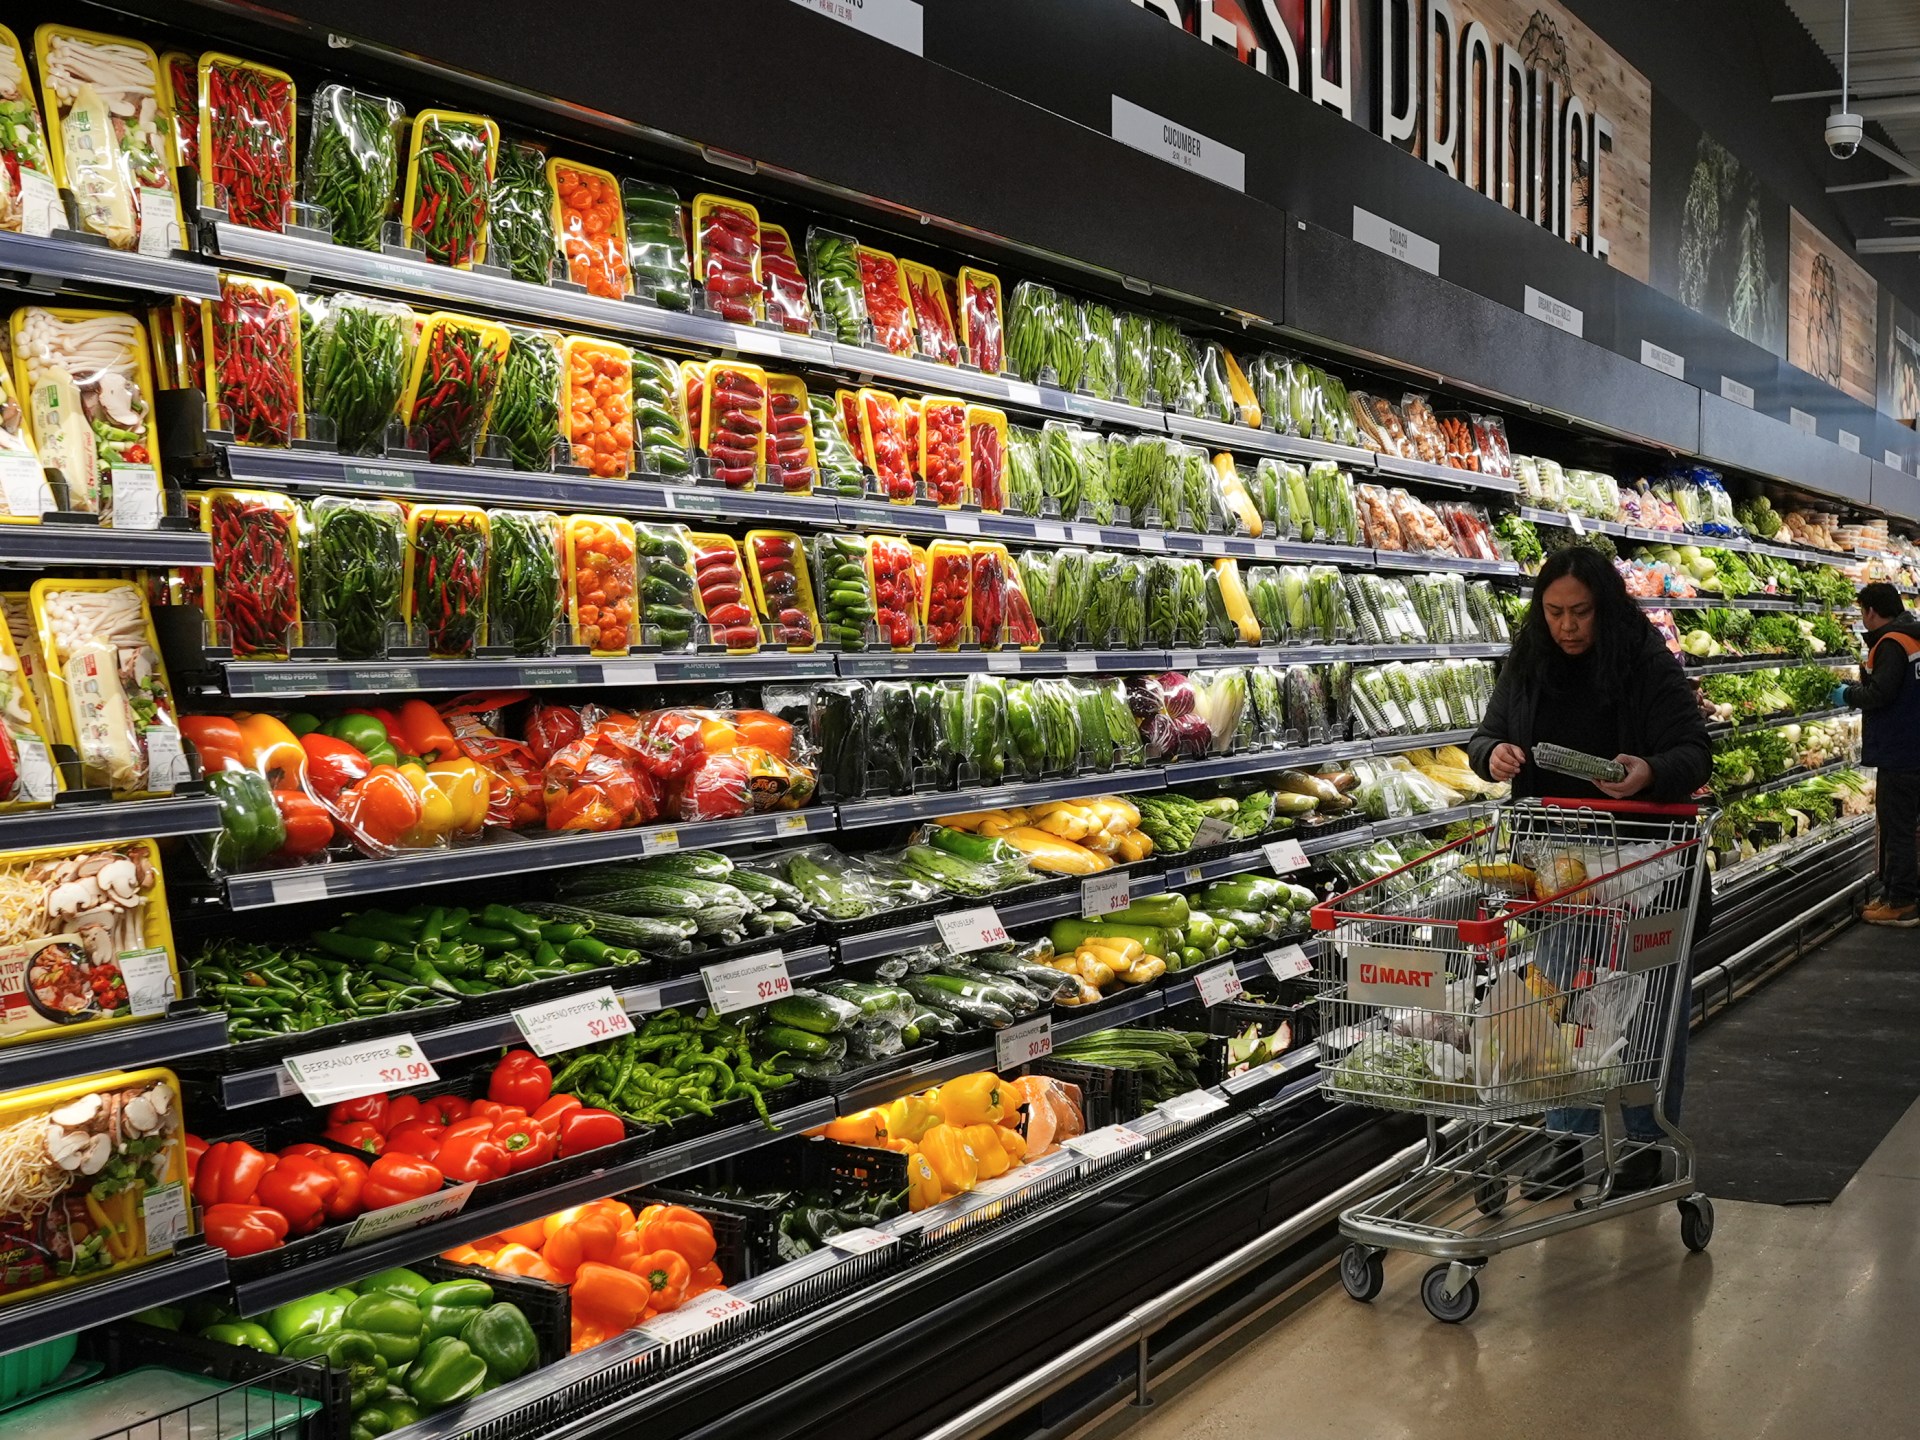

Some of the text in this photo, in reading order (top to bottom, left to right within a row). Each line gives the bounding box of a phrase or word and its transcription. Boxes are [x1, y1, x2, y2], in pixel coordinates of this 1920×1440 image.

[1163, 124, 1201, 158] CUCUMBER
[1390, 227, 1408, 249] SQUASH
[383, 470, 404, 478] PEPPER
[390, 671, 412, 679] PEPPER
[943, 917, 975, 931] CACTUS LEAF
[981, 927, 1006, 944] $1.49
[1643, 930, 1673, 949] MART
[4, 961, 24, 974] TOFU
[712, 963, 769, 983] HOT HOUSE CUCUMBER
[1379, 967, 1434, 988] MART
[0, 975, 20, 992] KIT
[757, 976, 789, 1000] $2.49
[567, 1001, 598, 1016] PEPPER
[587, 1013, 628, 1039] $2.49
[1028, 1037, 1050, 1057] $0.79
[302, 1048, 395, 1074] SERRANO PEPPER
[378, 1062, 431, 1083] $2.99
[362, 1208, 408, 1229] HOLLAND
[407, 1203, 429, 1217] RED
